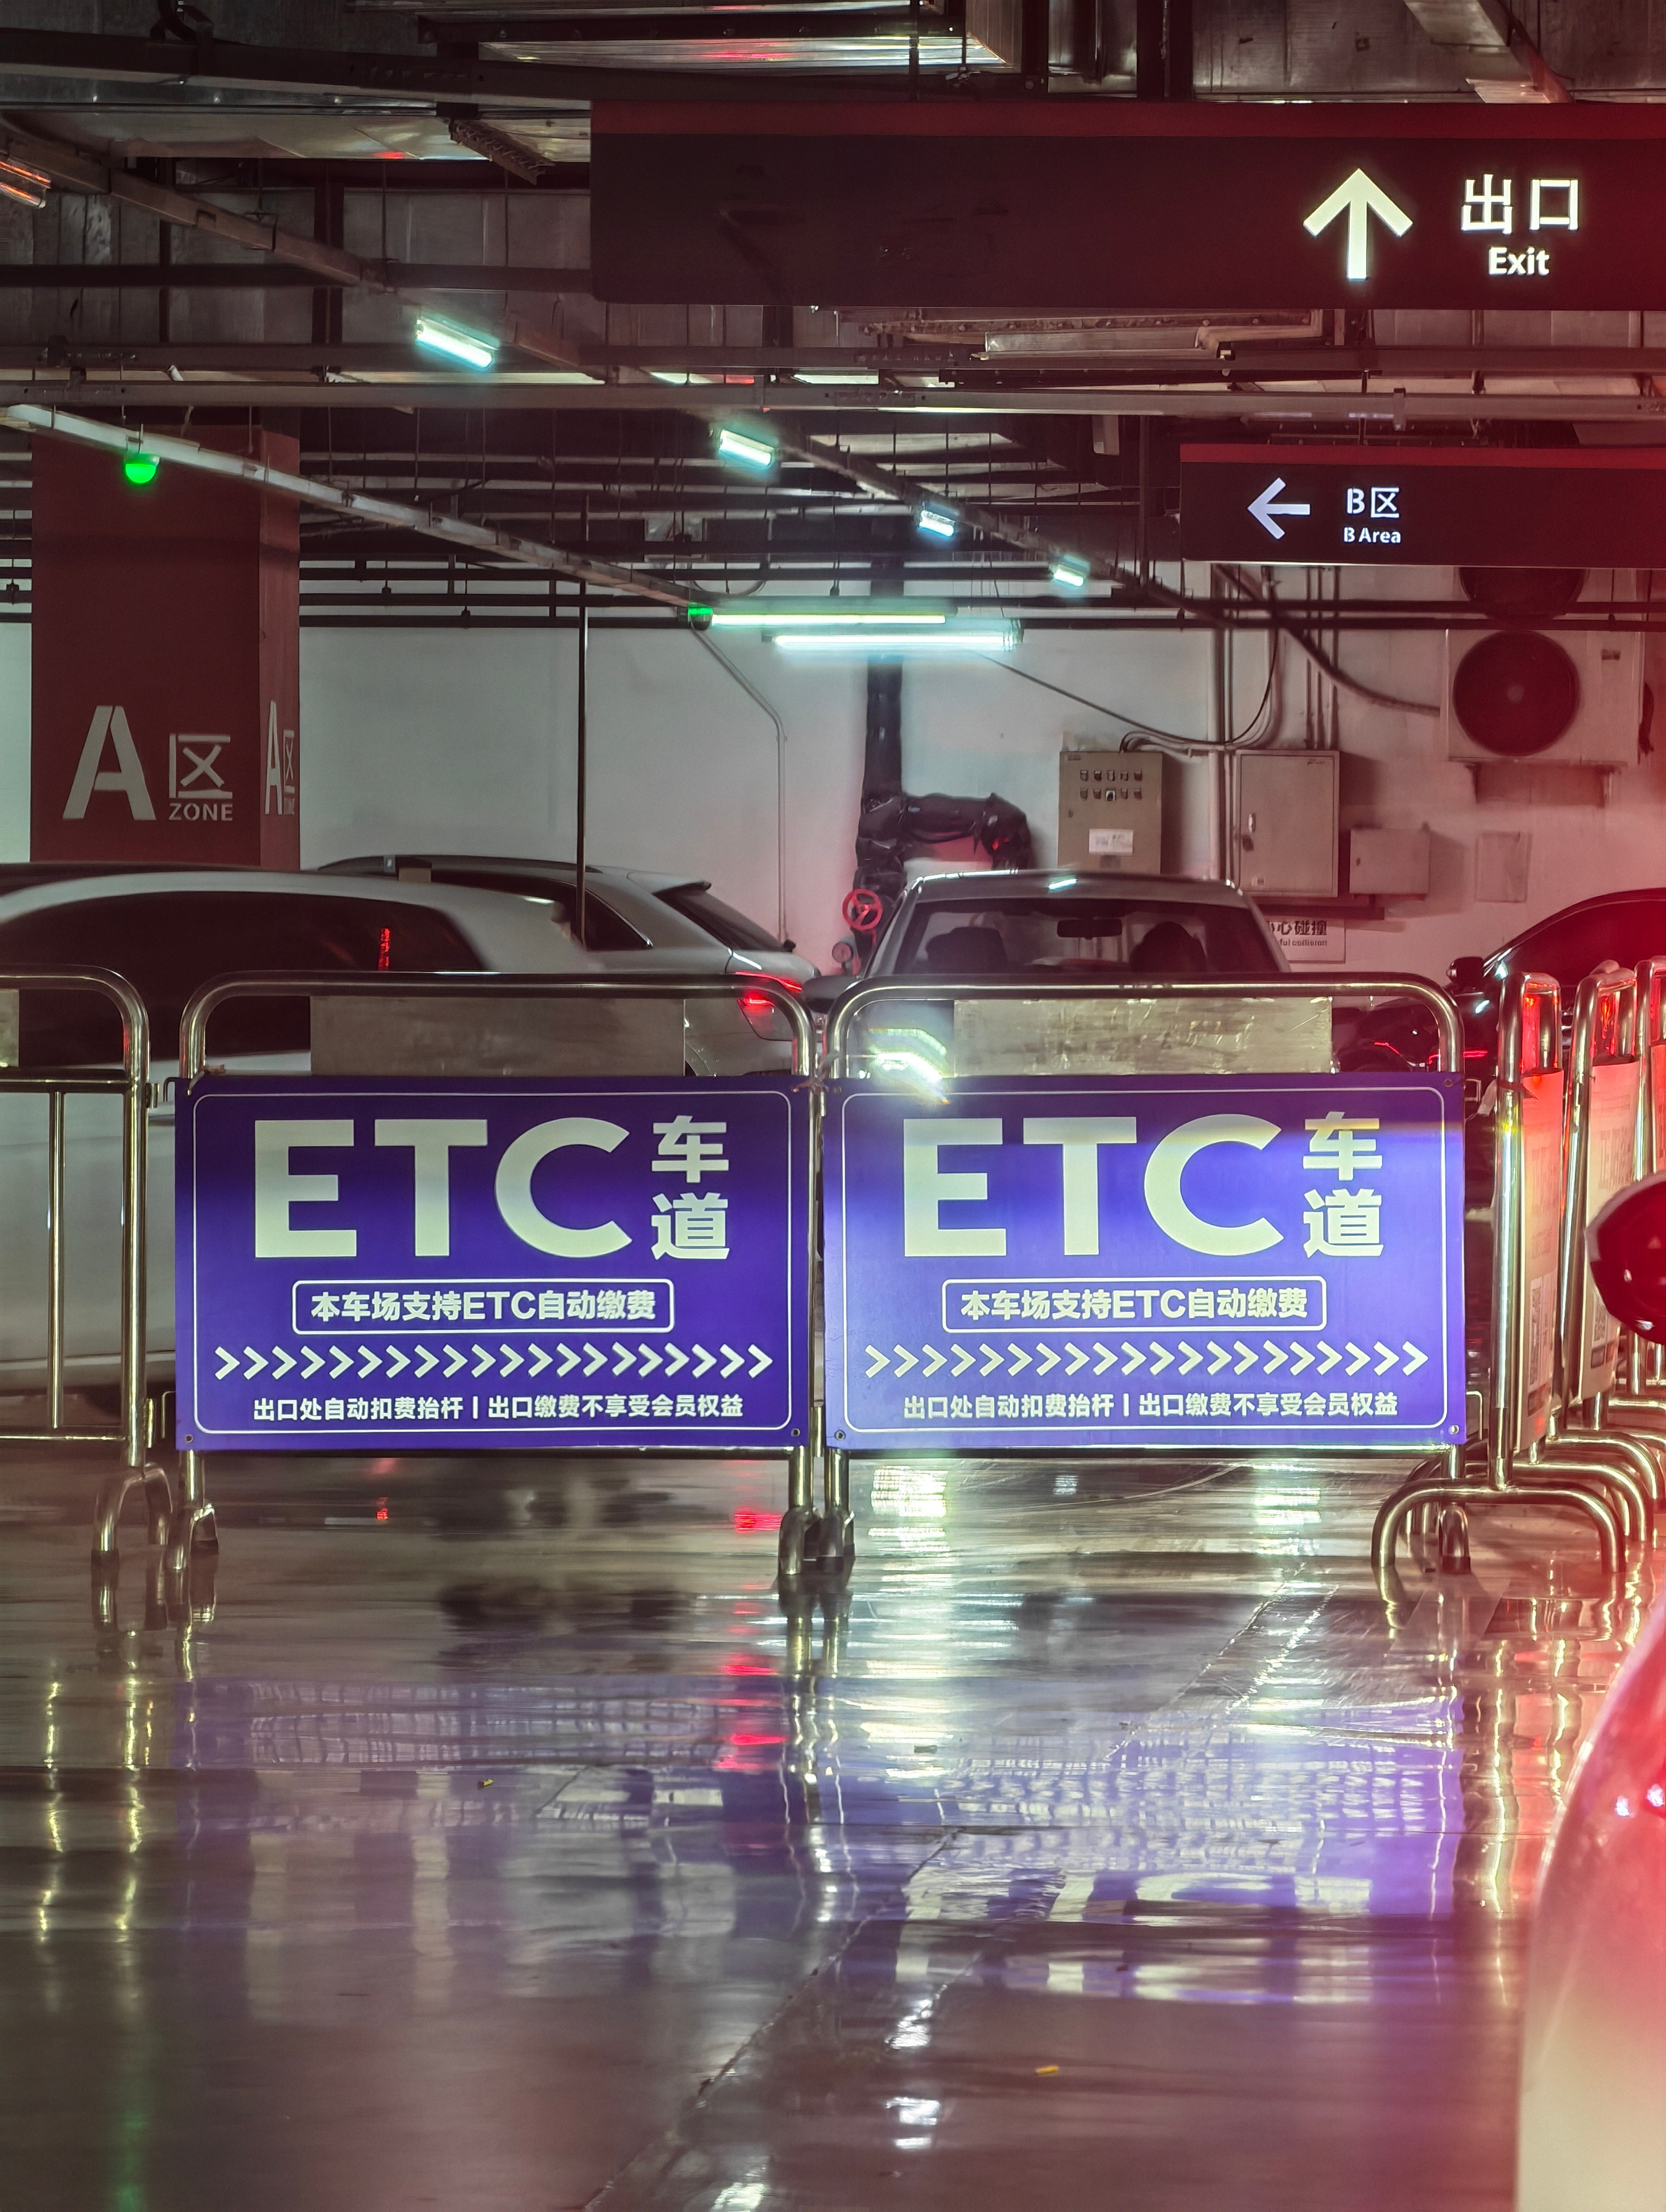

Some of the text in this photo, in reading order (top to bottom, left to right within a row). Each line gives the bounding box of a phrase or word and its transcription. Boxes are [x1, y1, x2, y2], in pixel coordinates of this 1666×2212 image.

[1461, 173, 1578, 235] 出口
[1489, 246, 1550, 276] Exit
[1347, 487, 1400, 518] B区
[1344, 527, 1401, 543] B Area
[169, 803, 233, 821] ZONE
[254, 1115, 730, 1260] ETC 车道
[903, 1113, 1284, 1257] ETC
[1303, 1111, 1384, 1258] 车道
[311, 1290, 656, 1322] 本车场支持ETC自动缴费
[960, 1288, 1308, 1321] 本车场支持ETC自动缴费
